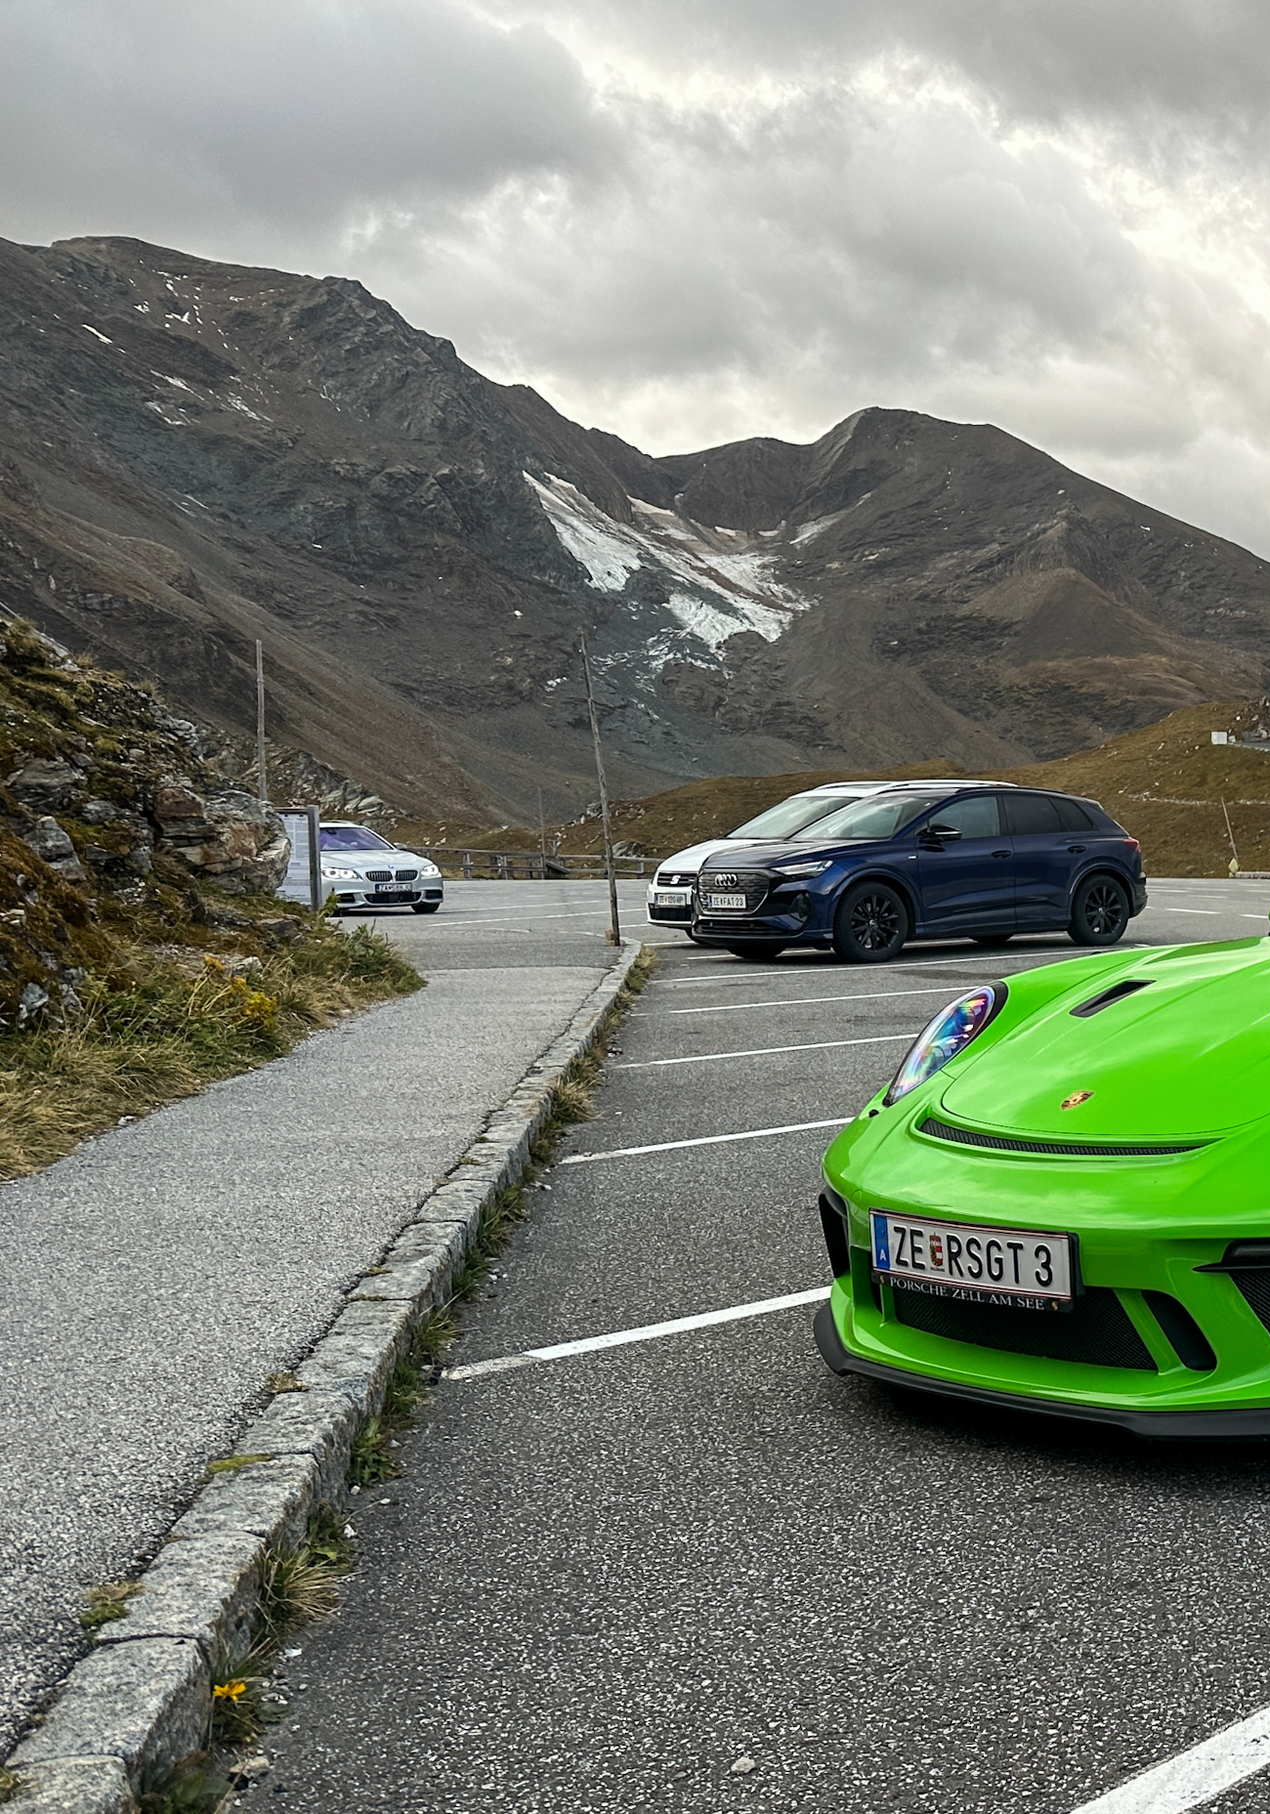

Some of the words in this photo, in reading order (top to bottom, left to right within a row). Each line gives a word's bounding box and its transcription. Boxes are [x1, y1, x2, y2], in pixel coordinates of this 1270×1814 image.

[879, 1251, 887, 1262] A
[893, 1226, 926, 1270] ZE
[946, 1234, 1024, 1284] RSGT
[1034, 1245, 1053, 1287] 3
[889, 1277, 948, 1297] PORSCHE
[951, 1288, 985, 1303] ZELL
[989, 1293, 1013, 1306] AM
[1017, 1298, 1046, 1311] SEE
